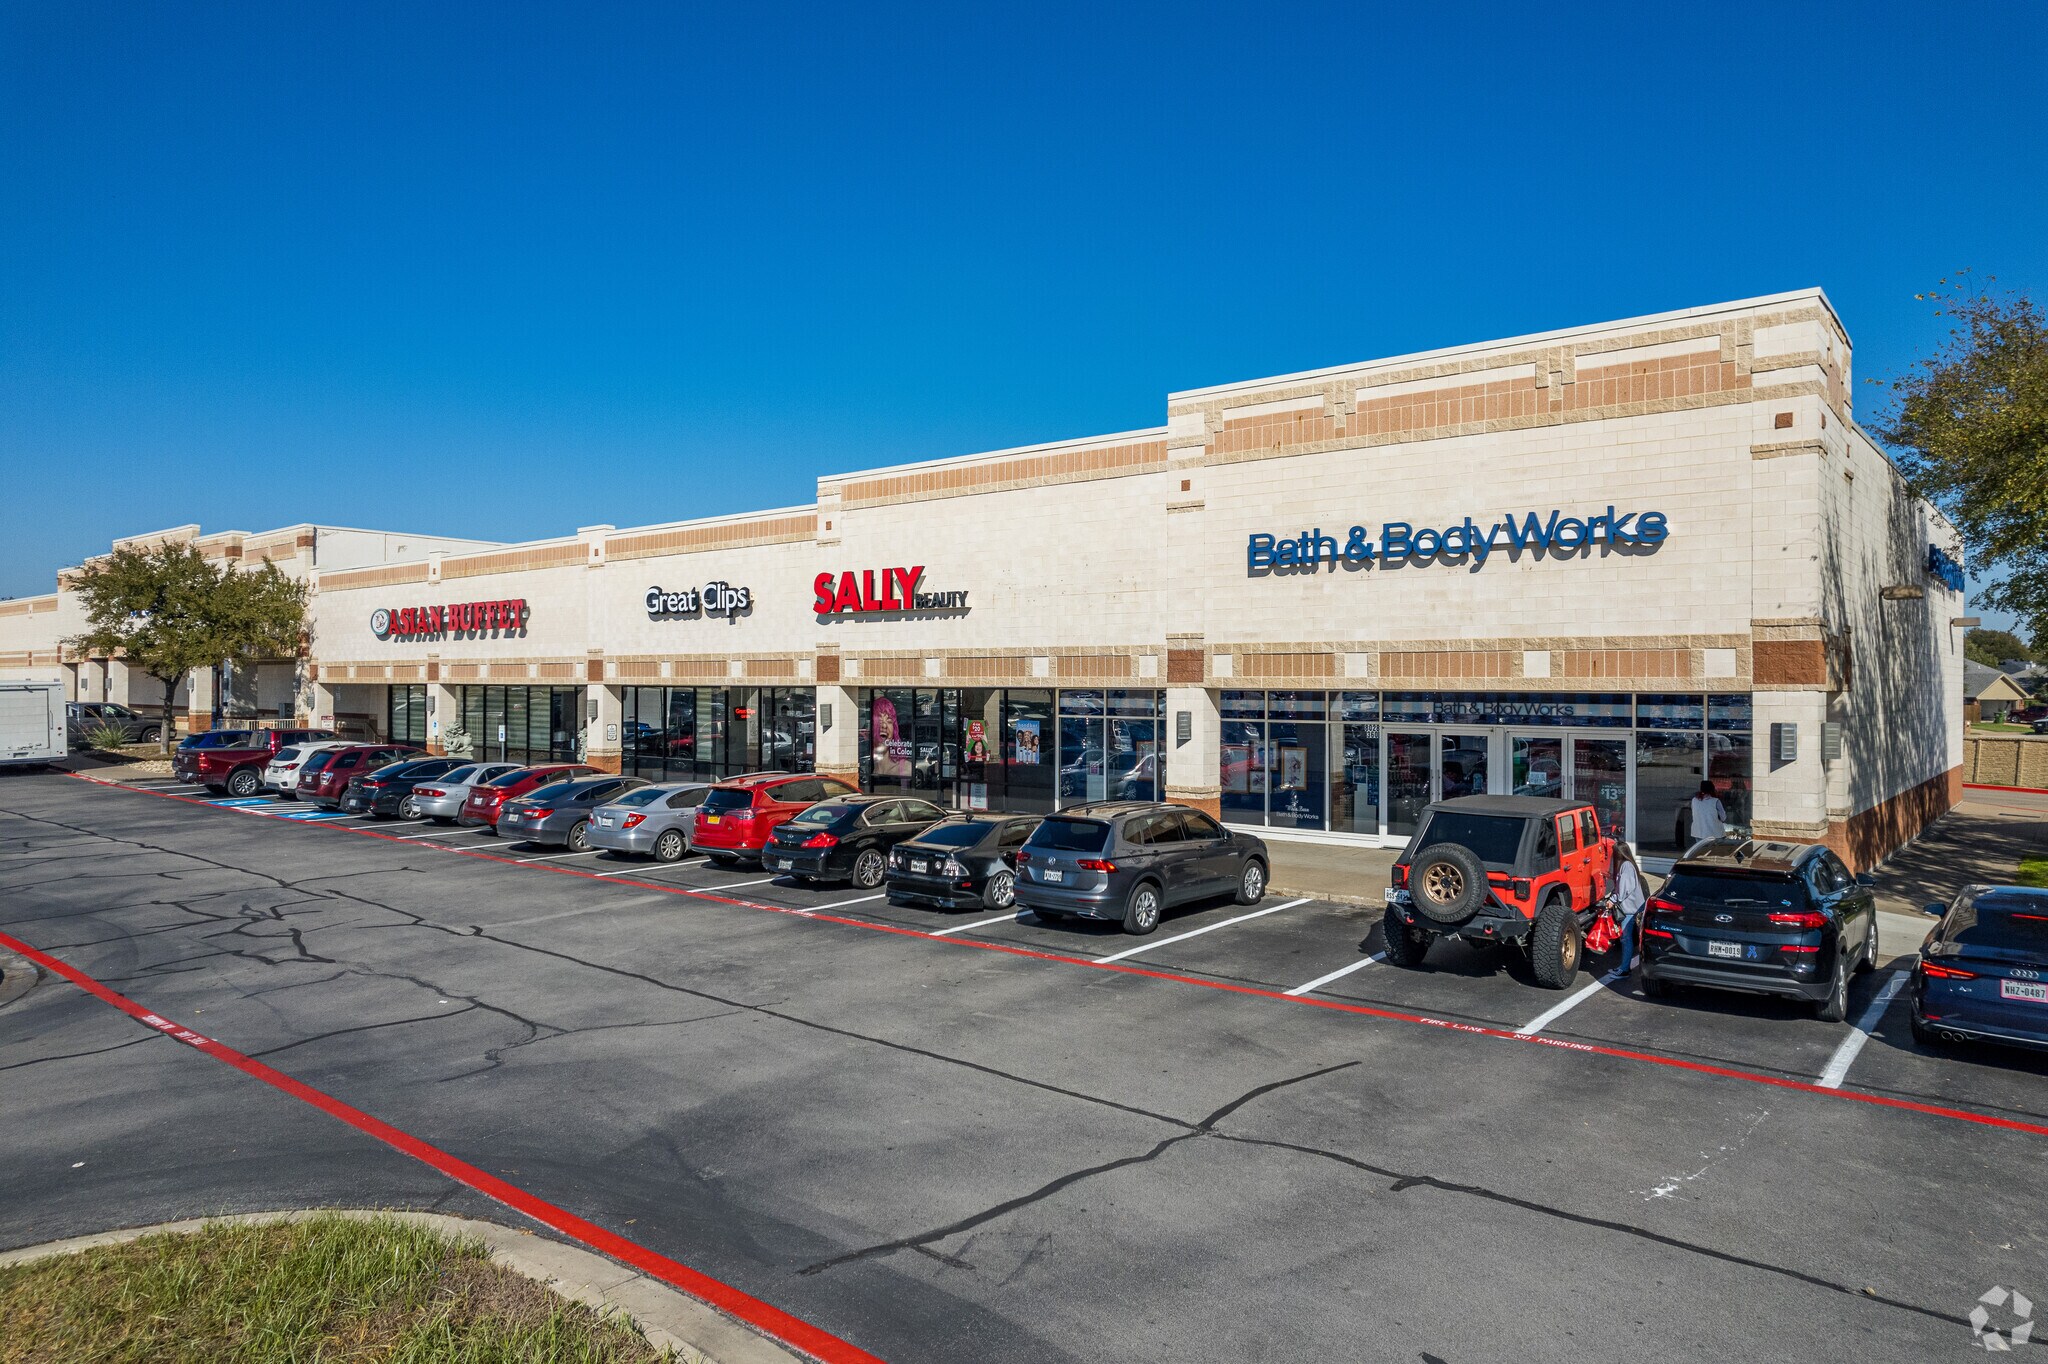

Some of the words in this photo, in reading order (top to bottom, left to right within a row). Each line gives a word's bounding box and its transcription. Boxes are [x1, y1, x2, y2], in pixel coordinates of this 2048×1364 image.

[1249, 528, 1338, 567] Bath
[1344, 525, 1376, 560] &
[1383, 517, 1500, 561] Body
[1505, 505, 1669, 549] Works
[644, 587, 698, 613] Great
[701, 582, 748, 616] Clips
[813, 566, 925, 614] SALLY
[915, 591, 968, 608] BEAUTY
[388, 606, 442, 634] ASIAN
[448, 599, 524, 631] BUFFET
[1433, 702, 1466, 714] Bath
[1469, 702, 1480, 714] &
[1483, 703, 1522, 716] Body
[1525, 703, 1574, 716] Works
[1420, 1017, 1448, 1027] FIRE
[1452, 1024, 1486, 1033] LANE
[1513, 1033, 1532, 1041] NO
[1537, 1038, 1594, 1051] PARKING
